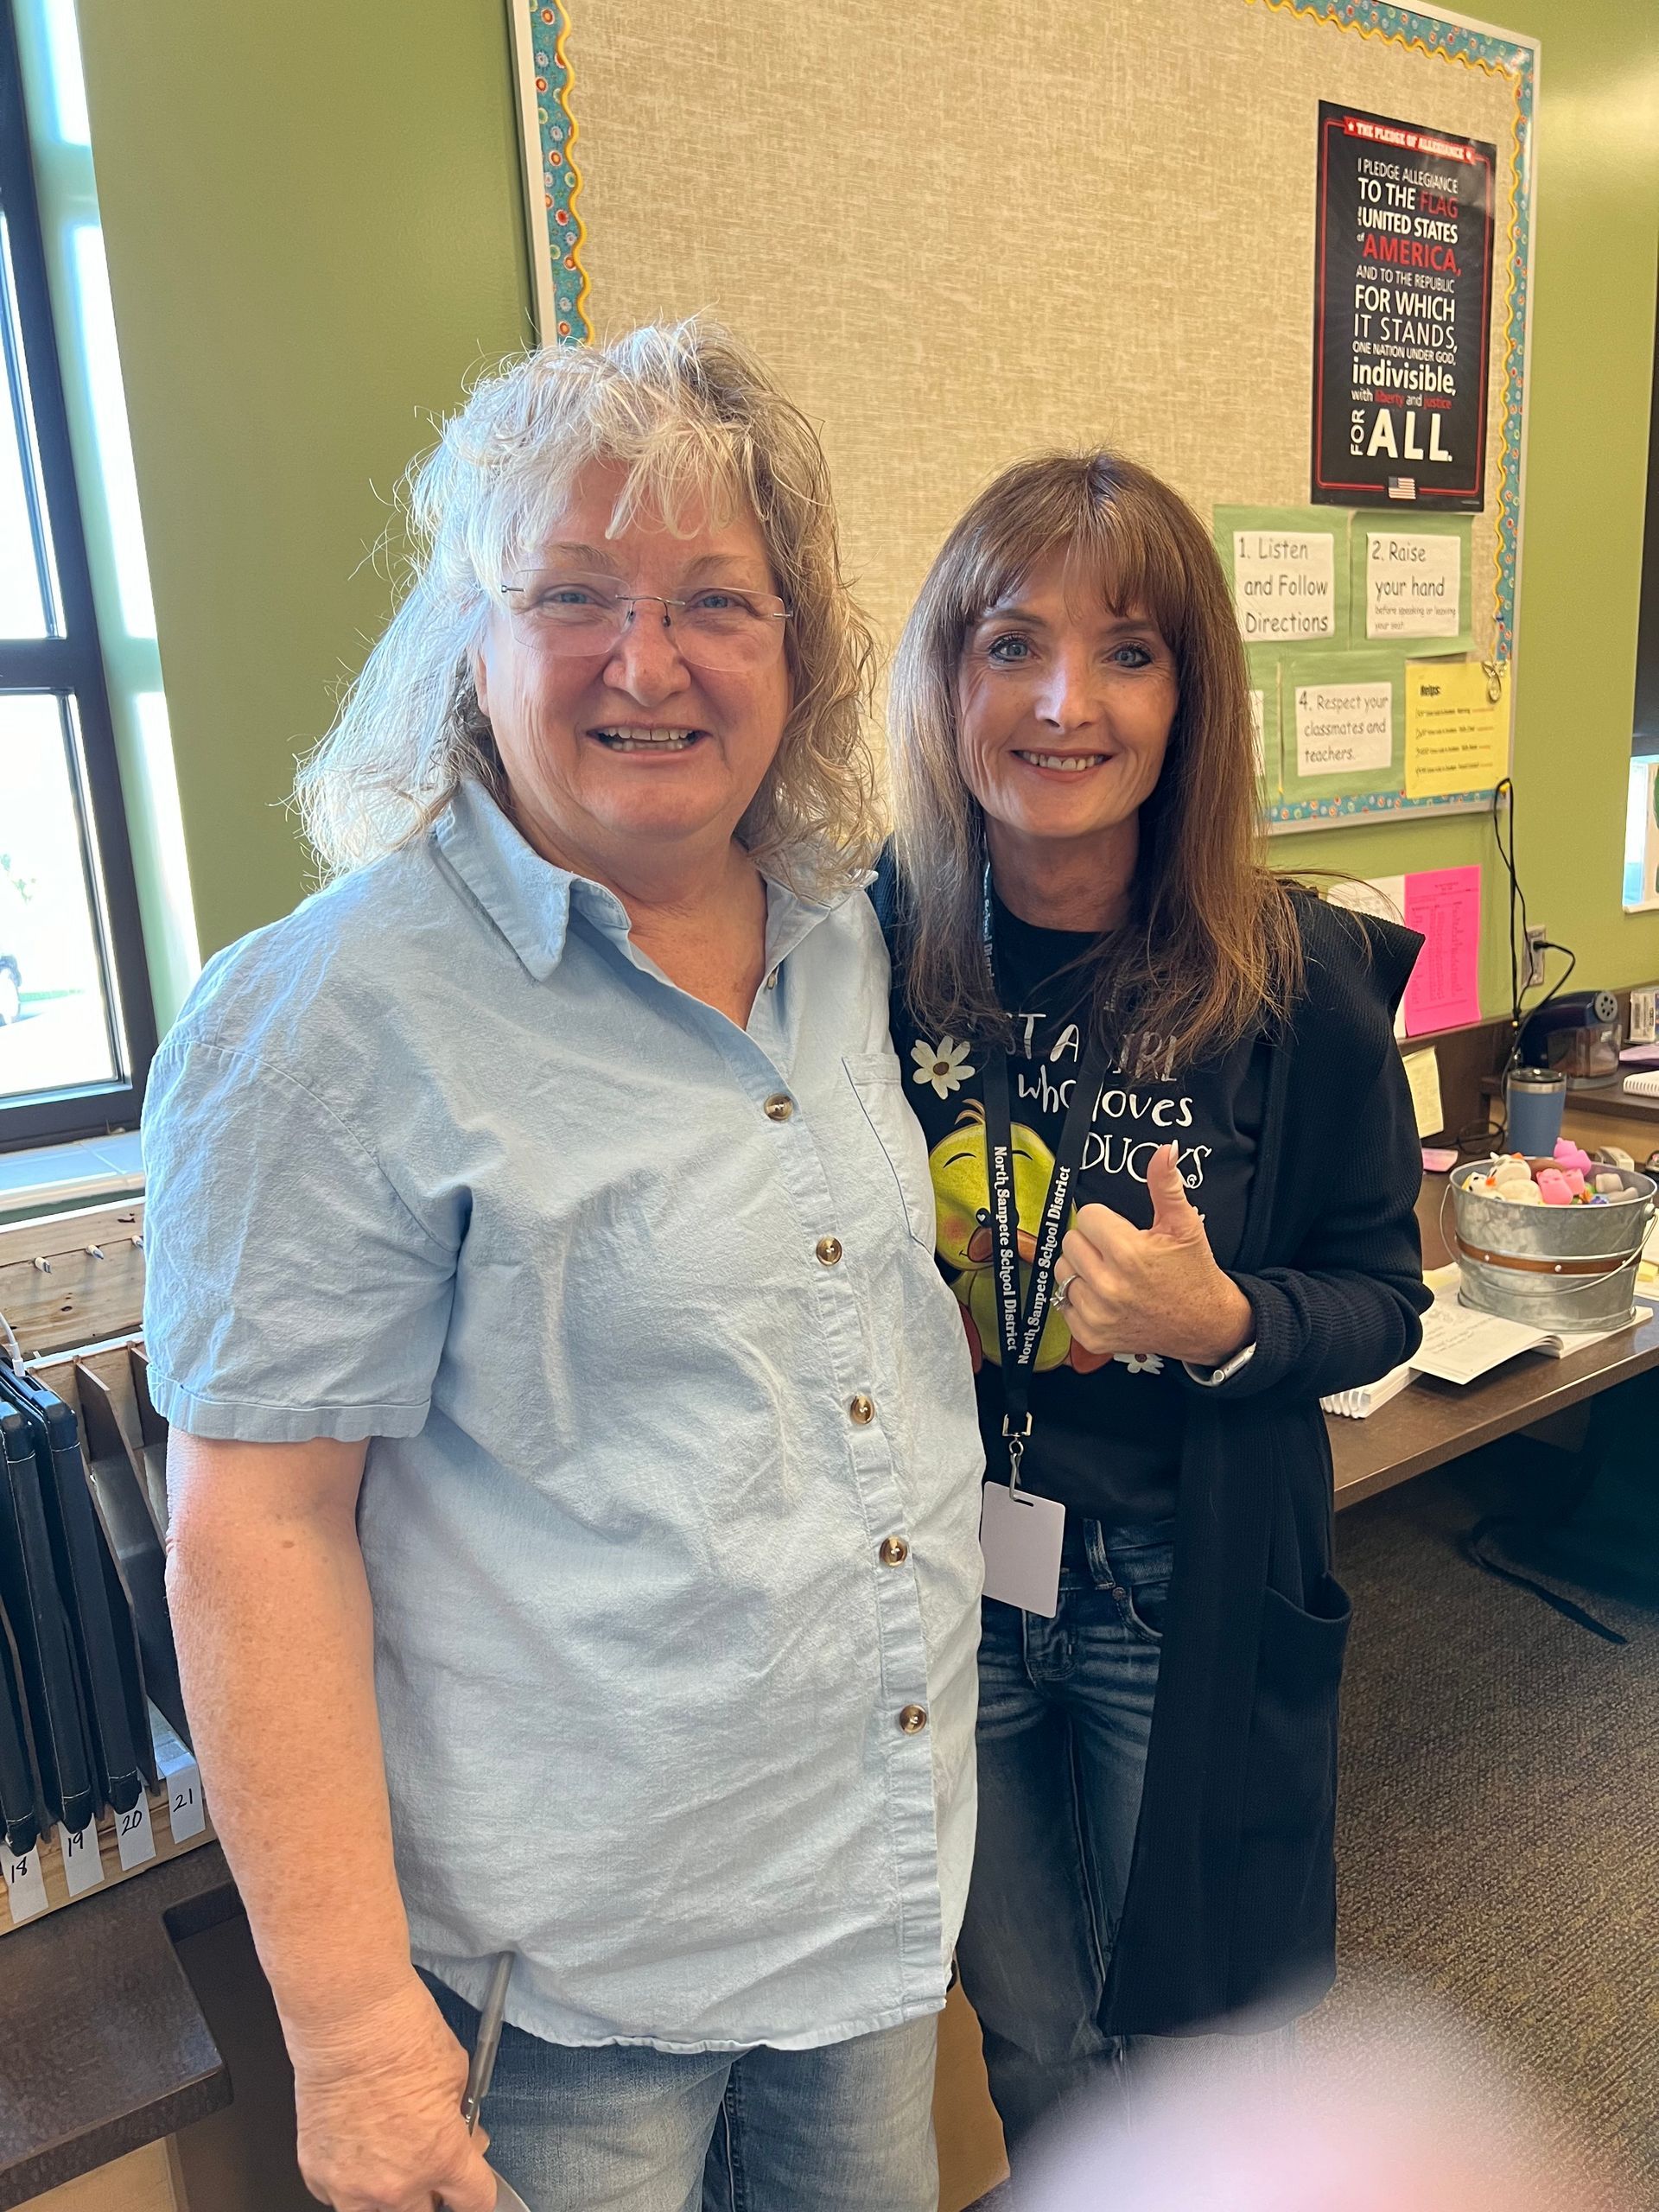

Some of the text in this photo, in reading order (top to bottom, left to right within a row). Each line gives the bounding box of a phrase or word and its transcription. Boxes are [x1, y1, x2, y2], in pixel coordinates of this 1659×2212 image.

[1356, 122, 1374, 138] THE
[1363, 159, 1401, 181] PLEDGE
[1402, 167, 1459, 194] ALLEGIANCE
[1357, 177, 1459, 219] TO THE FLAG
[1362, 207, 1412, 235] UNITED
[1414, 217, 1459, 245] STATES
[1362, 232, 1462, 276] AMERICA,
[1356, 264, 1455, 294] AND TO THE REPUBLIC
[1355, 283, 1455, 323] FOR WHICH
[1354, 313, 1459, 353] IT STANDS,
[1352, 340, 1372, 354] ONE
[1372, 343, 1406, 359] NATION
[1406, 347, 1435, 363] UNDER
[1352, 355, 1458, 397] indivisible,
[1351, 387, 1453, 410] with liberty and justice
[1350, 409, 1366, 456] FOR
[1366, 408, 1453, 462] ALL.
[1239, 537, 1309, 560] 1. Listen
[1371, 540, 1427, 563] 2. Raise
[1244, 574, 1329, 597] and Follow
[1375, 575, 1446, 602] your hand
[1244, 611, 1329, 633] Directions
[1375, 605, 1397, 615] before
[1298, 690, 1389, 715] 4. Respect your
[1303, 717, 1387, 738] classmates and
[1049, 1023, 1080, 1063] A
[1091, 1080, 1194, 1128] loves
[994, 1146, 1010, 1190] North
[995, 1188, 1011, 1246] Sanpete
[999, 1249, 1016, 1296] School
[1017, 1165, 1071, 1365] North Sanpete School District
[173, 1788, 194, 1814] 21
[121, 1809, 143, 1837] 20
[67, 1829, 84, 1858] 19
[10, 1855, 28, 1884] 18
